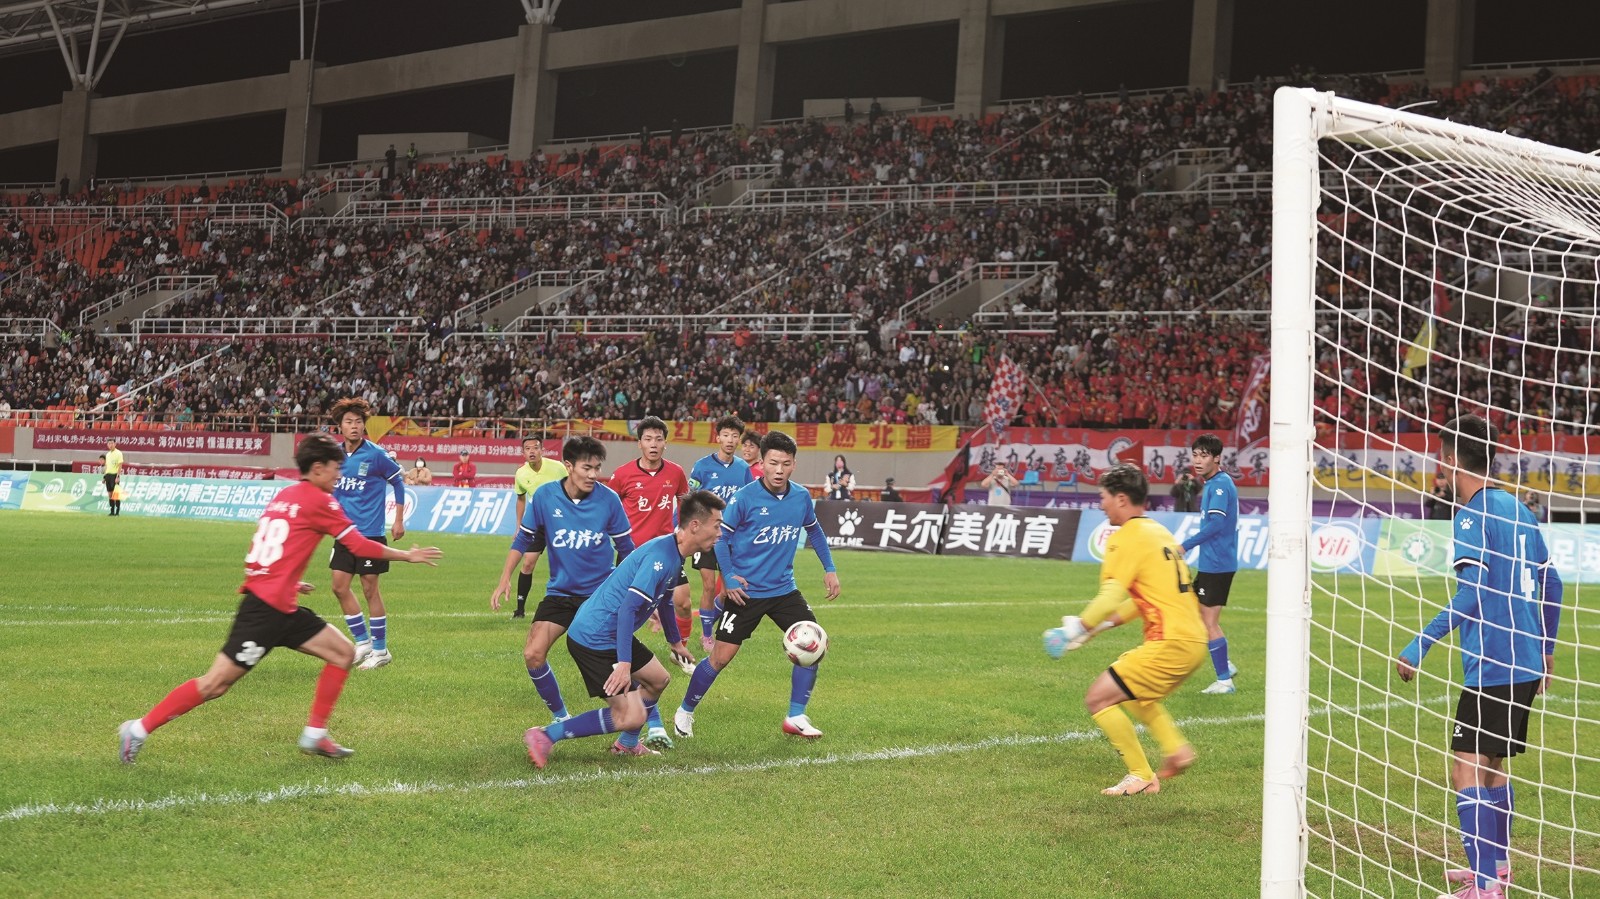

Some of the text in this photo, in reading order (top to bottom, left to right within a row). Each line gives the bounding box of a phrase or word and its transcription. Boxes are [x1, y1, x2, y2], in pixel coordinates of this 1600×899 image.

[333, 475, 367, 491] 彦淖尔
[712, 485, 741, 499] 巴彦淖
[92, 480, 281, 506] 25年伊利内蒙古自治区足
[142, 503, 187, 515] MONGOLIA
[189, 505, 234, 518] FOOTBALL
[427, 489, 513, 534] 伊利
[637, 494, 672, 512] 包头
[873, 509, 1059, 555] 卡尔美体育
[826, 536, 865, 547] KELME
[1317, 536, 1352, 556] Yili
[693, 551, 701, 565] 9
[719, 611, 738, 634] 14
